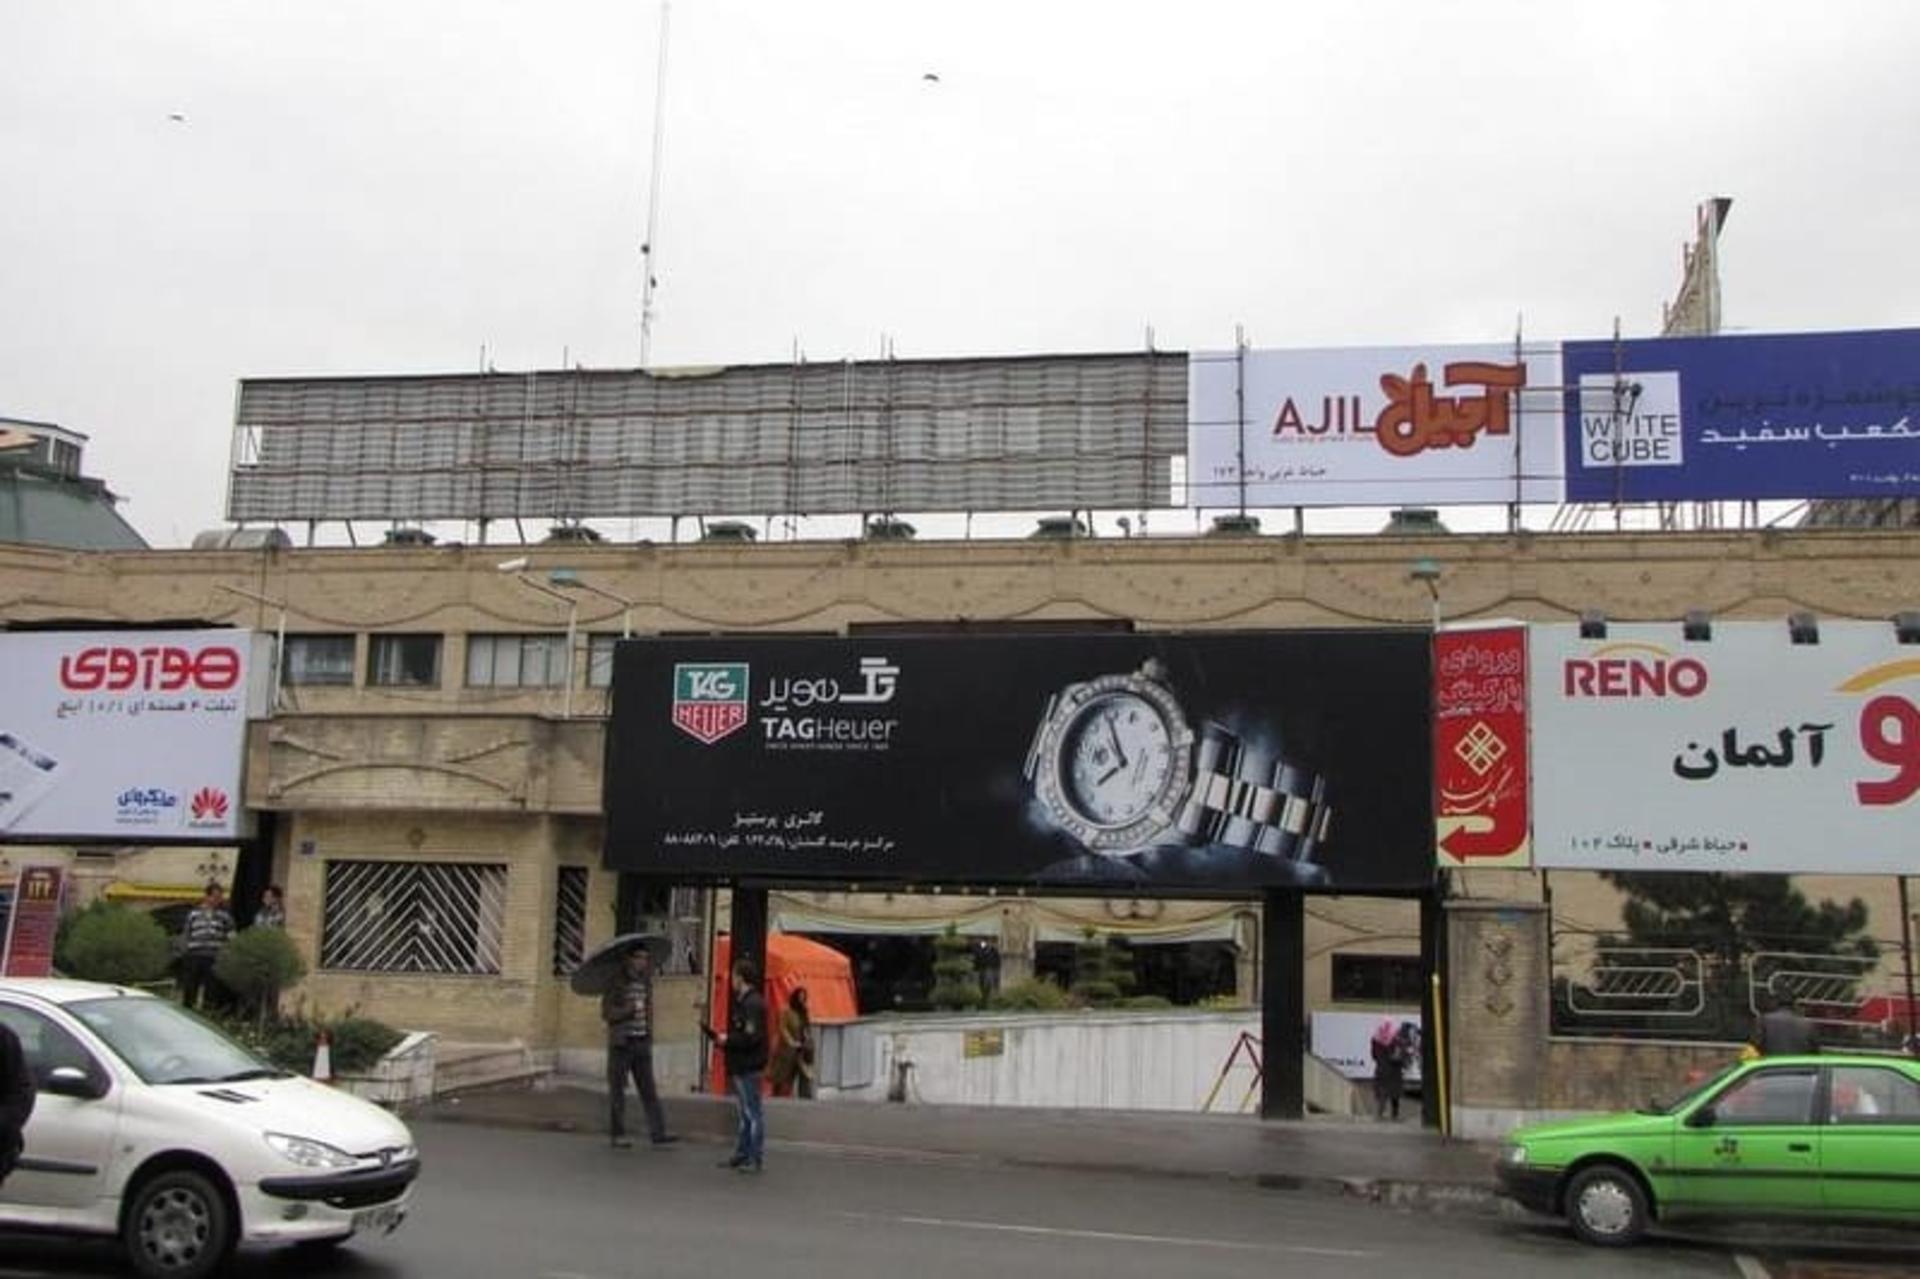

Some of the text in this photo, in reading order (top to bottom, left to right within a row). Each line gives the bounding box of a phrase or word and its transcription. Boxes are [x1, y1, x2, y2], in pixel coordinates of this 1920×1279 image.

[1273, 396, 1377, 435] AJIL
[1590, 438, 1671, 461] CUBE
[1700, 420, 1810, 450] سفید
[687, 670, 736, 700] TAG
[1564, 658, 1708, 698] RENO
[678, 705, 742, 738] HEUER
[1673, 722, 1835, 780] آلمان
[1655, 836, 1700, 854] شرقی
[1703, 836, 1737, 854] حیاط
